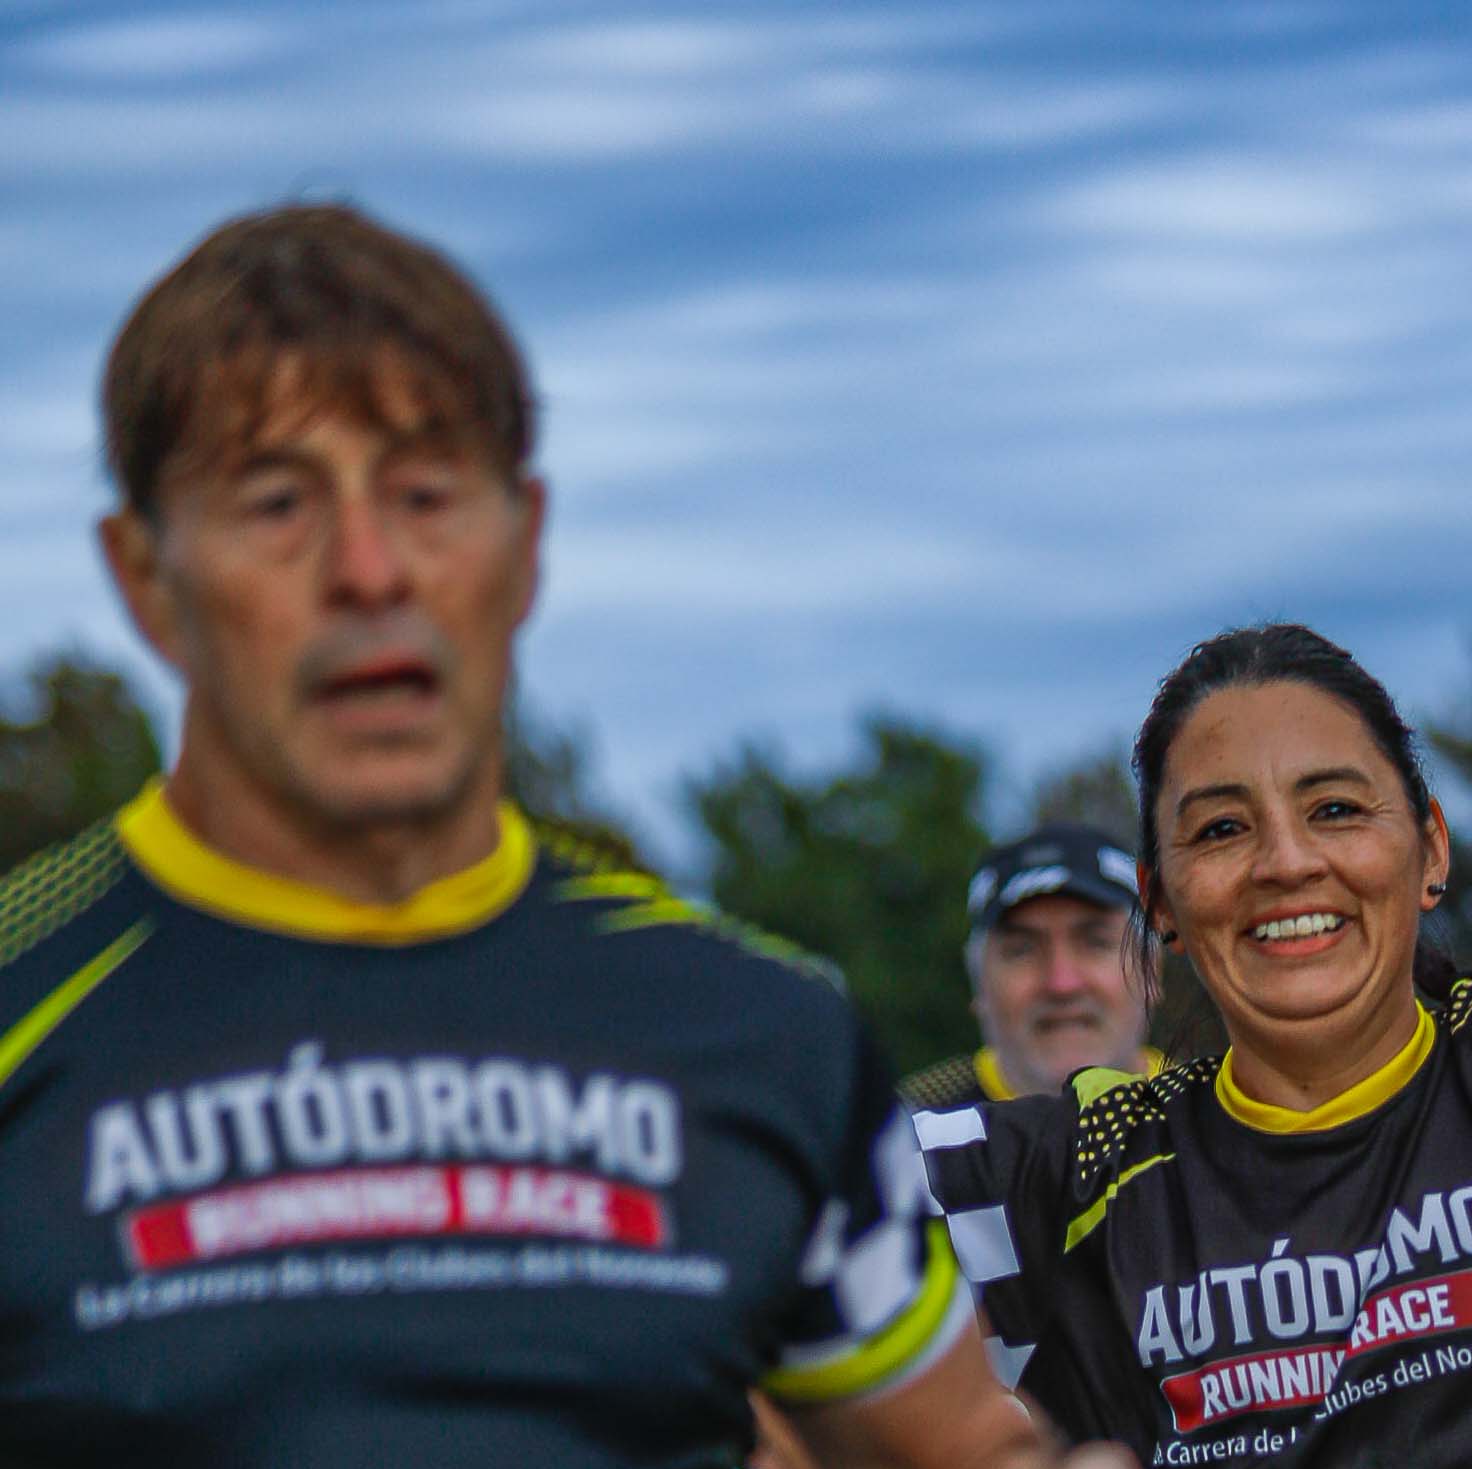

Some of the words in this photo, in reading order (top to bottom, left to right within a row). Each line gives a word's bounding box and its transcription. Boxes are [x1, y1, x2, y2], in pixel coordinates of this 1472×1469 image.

[86, 1041, 682, 1211] AUTÓDROMO
[1166, 1434, 1246, 1465] Carrera
[1254, 1427, 1284, 1453] de
[1315, 1372, 1388, 1419] lubes
[1394, 1353, 1431, 1386] del
[1201, 1350, 1346, 1419] RUNNIN
[1351, 1284, 1454, 1348] RACE
